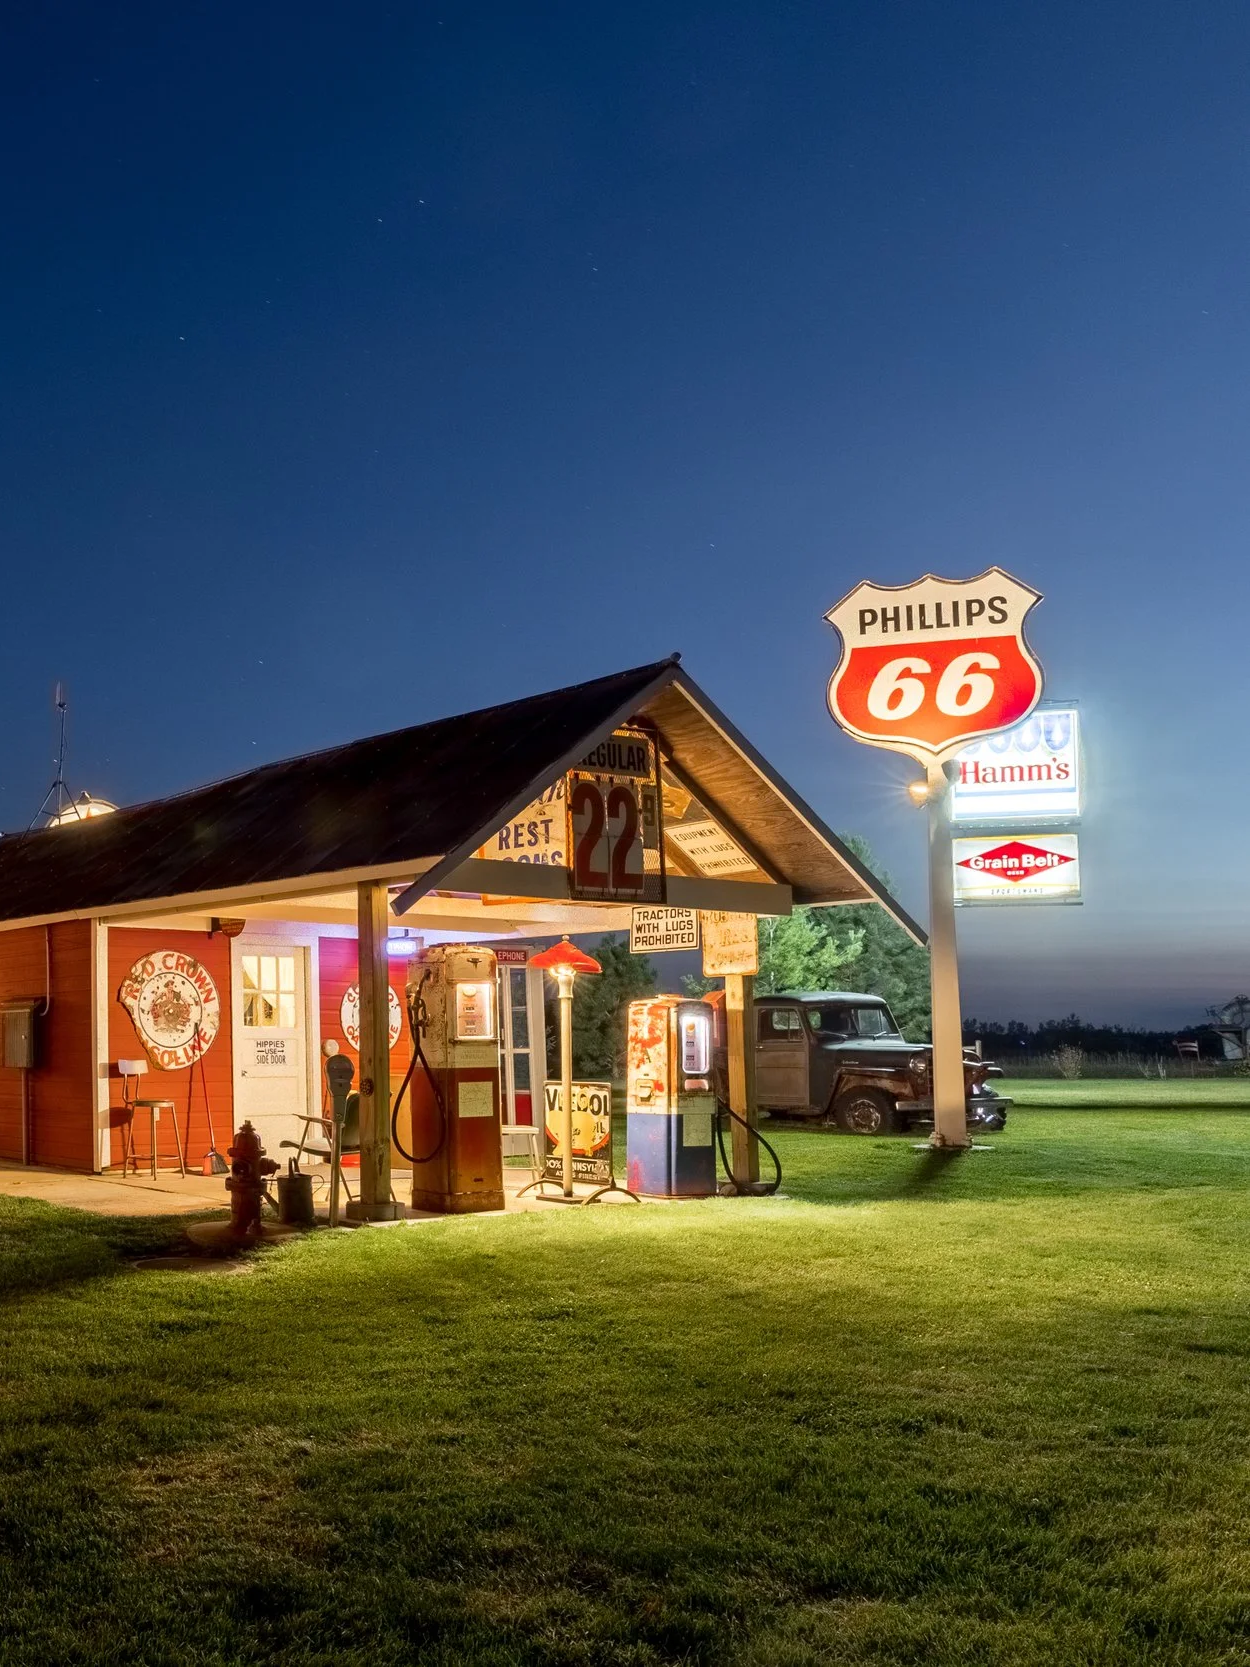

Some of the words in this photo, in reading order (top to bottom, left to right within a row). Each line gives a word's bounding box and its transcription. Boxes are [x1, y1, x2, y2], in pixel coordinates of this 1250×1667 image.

[858, 596, 1009, 635] PHILLIPS
[867, 652, 1000, 721] 66
[578, 742, 647, 773] EGULAR
[960, 757, 1070, 785] Hamm's
[498, 818, 554, 851] REST
[674, 828, 720, 842] EQUIPMENT
[688, 845, 710, 857] WITH
[712, 842, 735, 853] LUGS
[699, 856, 751, 871] PROHIBITED
[969, 855, 1020, 870] Grain
[1021, 853, 1060, 868] Belt
[636, 909, 692, 922] TRACTORS
[635, 922, 660, 934] WITH
[665, 919, 694, 932] LUGS
[634, 932, 695, 947] PROHIBITED
[497, 951, 526, 961] EPHONE
[125, 959, 156, 1001] RD
[161, 953, 217, 1005] CROWN
[145, 1027, 213, 1067] SOLINE
[256, 1040, 285, 1048] HIPPIES
[256, 1055, 269, 1064] SIDE
[270, 1055, 286, 1064] DOOR
